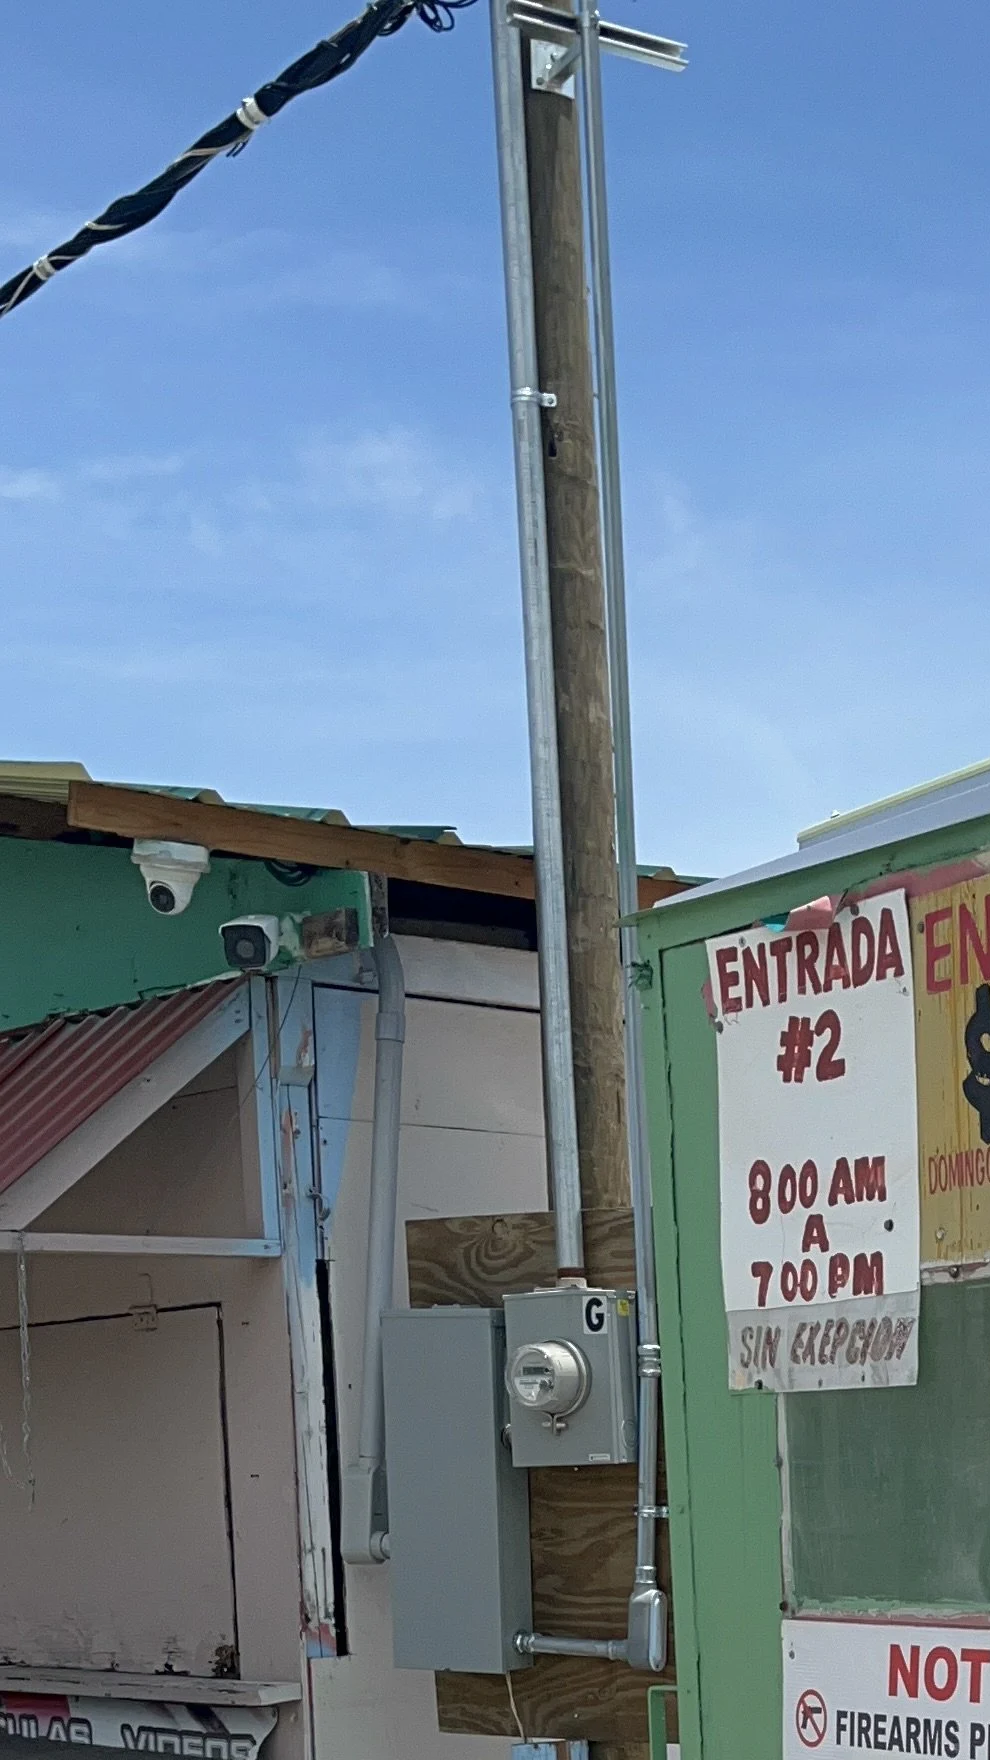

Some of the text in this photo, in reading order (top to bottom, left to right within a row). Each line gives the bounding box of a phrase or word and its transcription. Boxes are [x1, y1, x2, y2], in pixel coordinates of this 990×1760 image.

[716, 907, 905, 1016] ENTRADA
[777, 1009, 845, 1083] #2
[828, 1156, 887, 1207] AM
[802, 1214, 829, 1252] A
[828, 1251, 884, 1298] PM
[585, 1297, 605, 1333] G
[741, 1325, 781, 1370] SIN
[836, 1710, 959, 1758] FIREARMS
